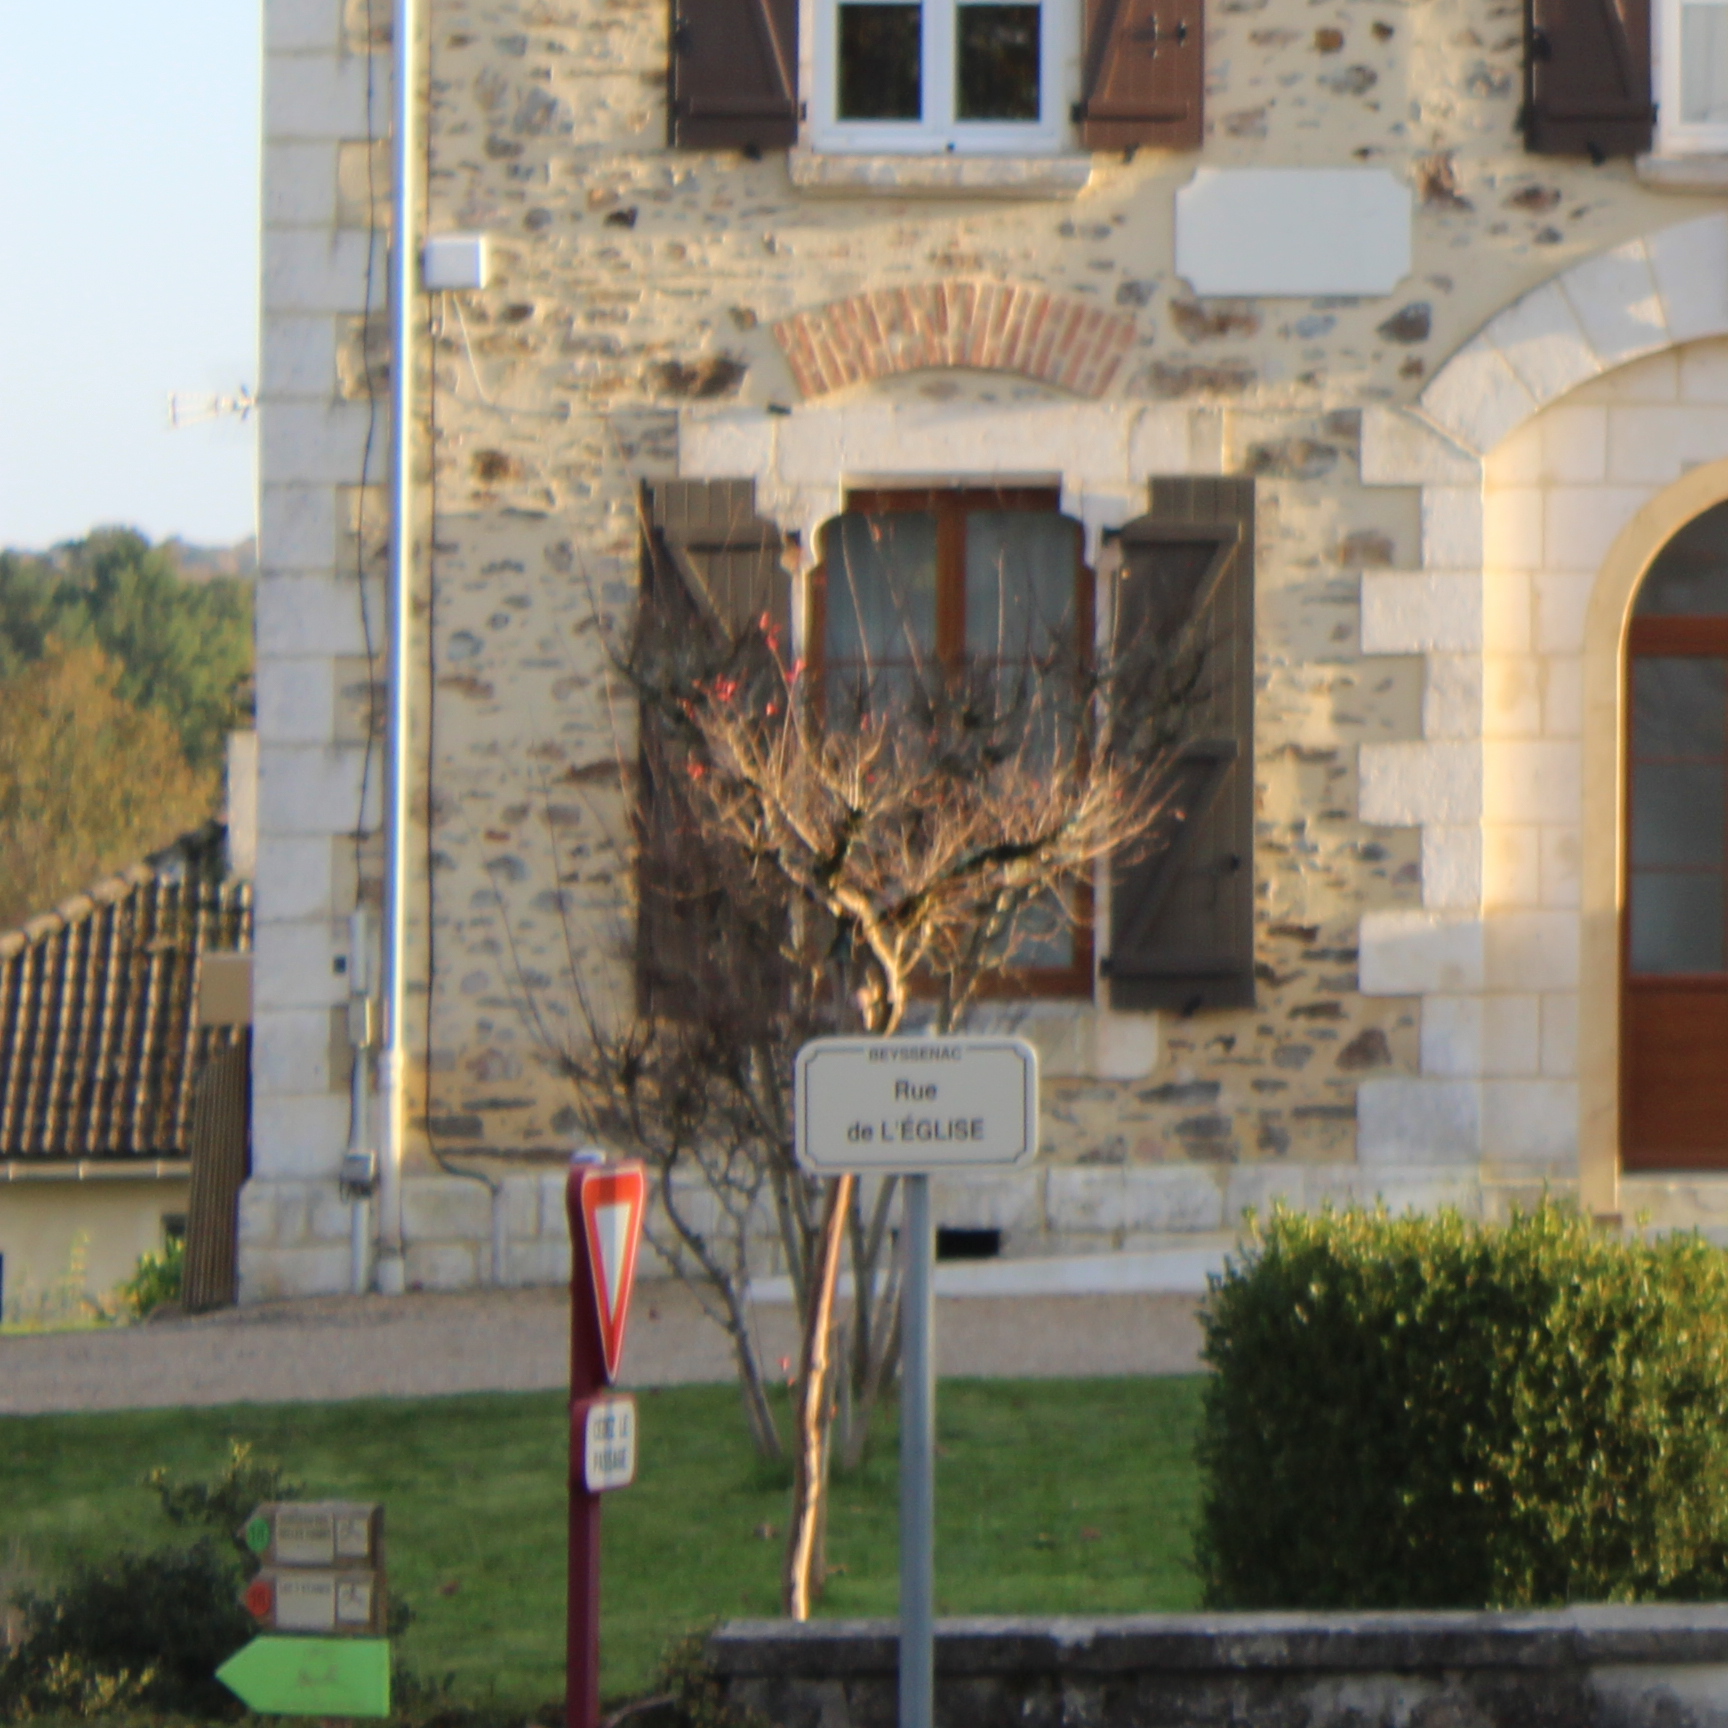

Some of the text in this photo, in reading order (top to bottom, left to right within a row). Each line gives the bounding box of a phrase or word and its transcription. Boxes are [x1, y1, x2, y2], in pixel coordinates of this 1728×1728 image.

[868, 1046, 963, 1062] BEYSSENAC
[894, 1078, 938, 1101] Rue
[847, 1114, 985, 1142] de L'ÉGLISE
